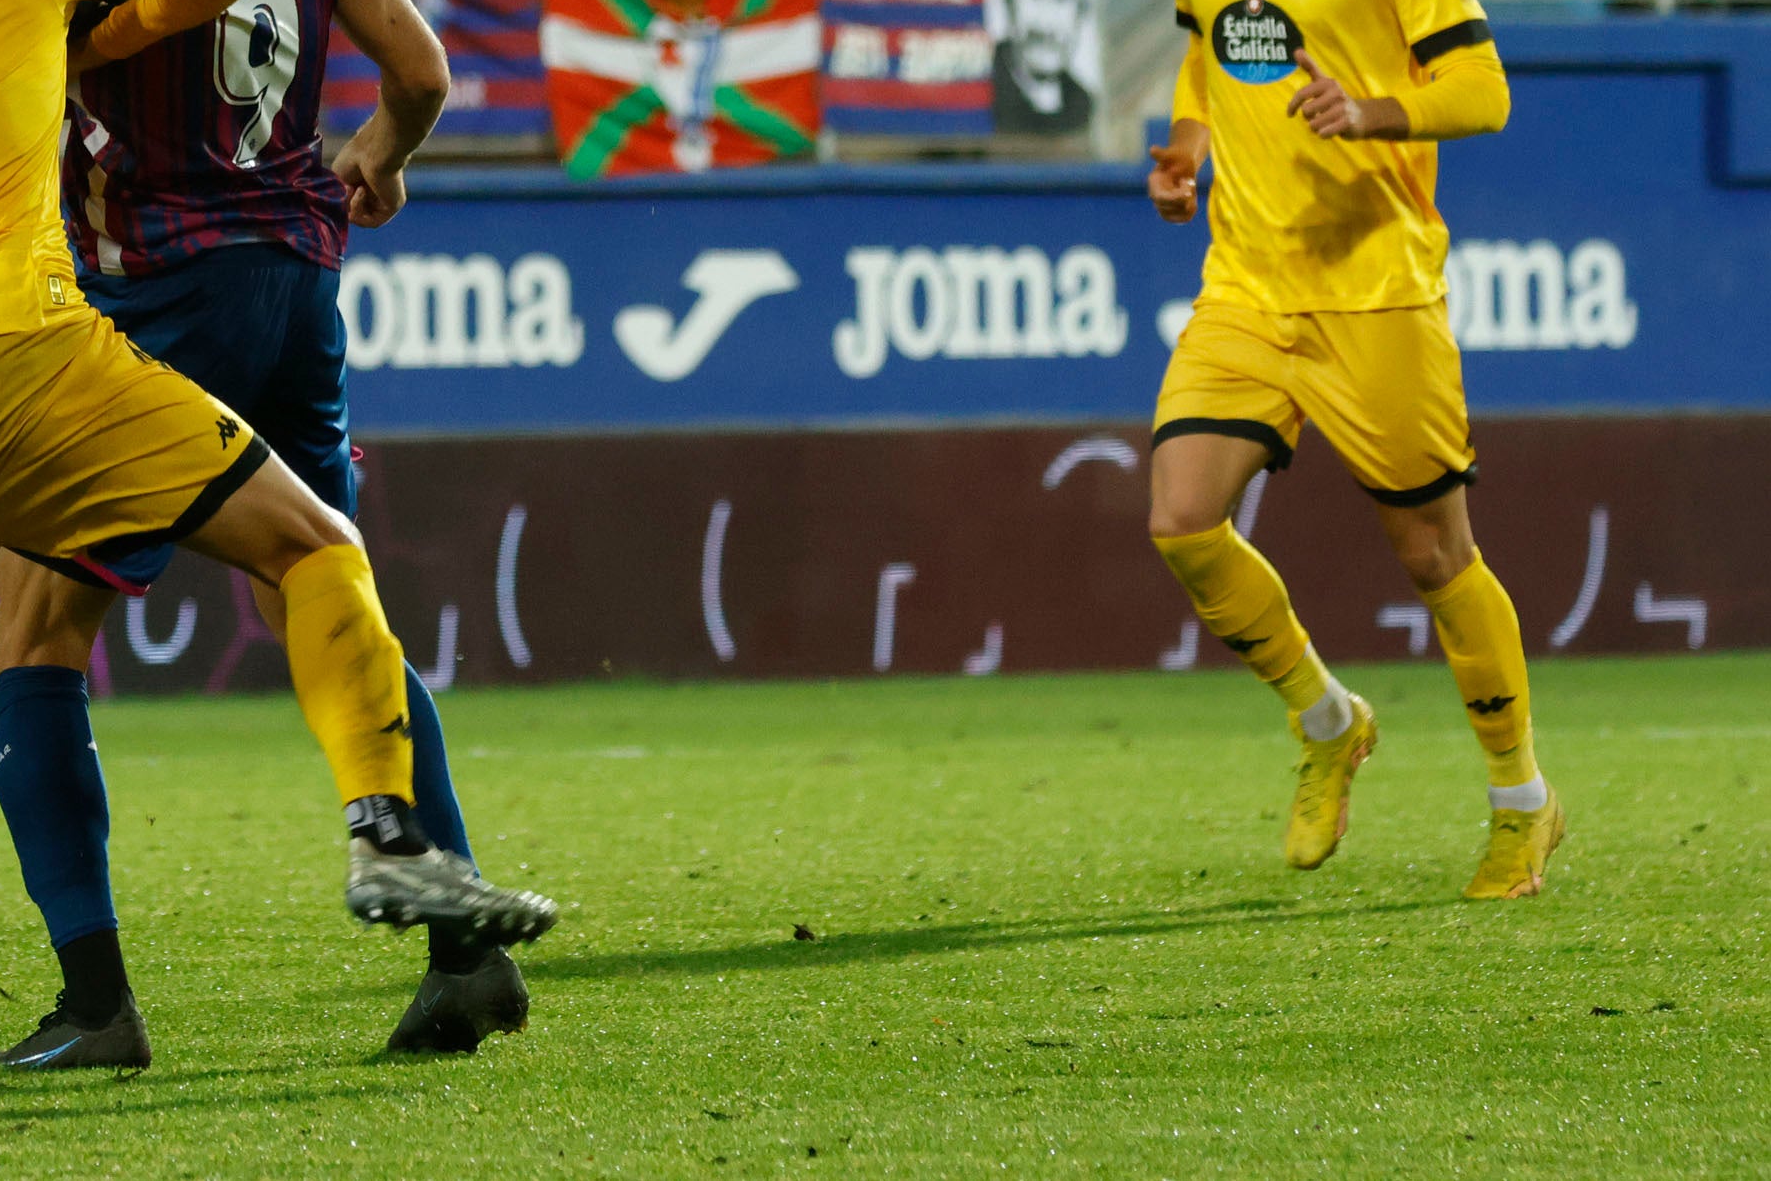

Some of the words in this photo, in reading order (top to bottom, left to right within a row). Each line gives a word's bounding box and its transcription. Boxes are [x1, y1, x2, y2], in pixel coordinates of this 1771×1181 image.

[1223, 13, 1288, 39] Estrella
[1225, 38, 1288, 62] Galicia
[337, 252, 586, 370] oma
